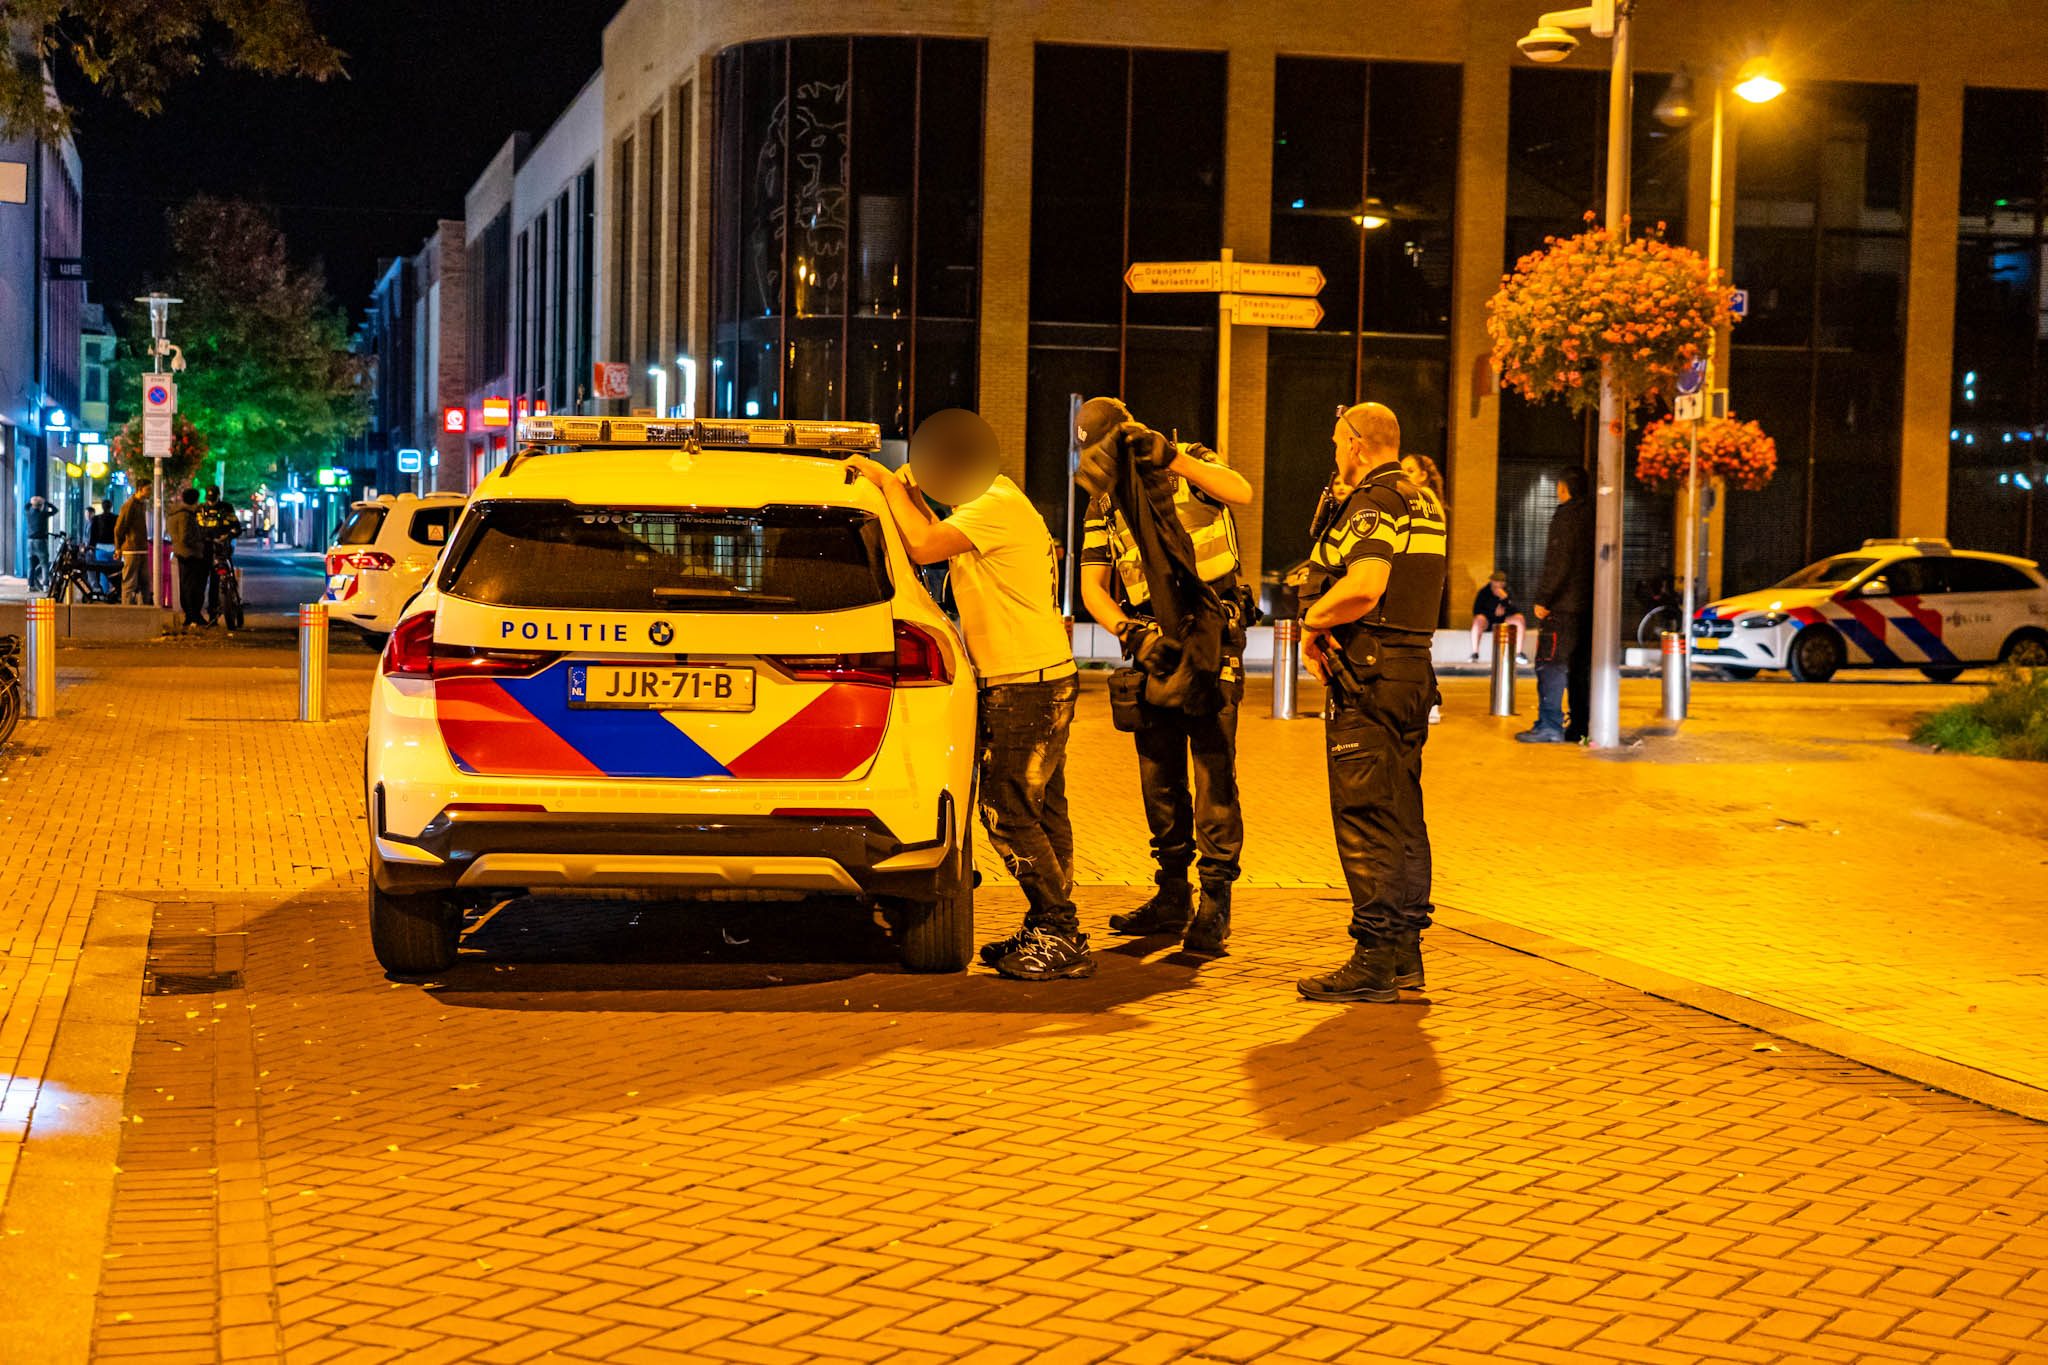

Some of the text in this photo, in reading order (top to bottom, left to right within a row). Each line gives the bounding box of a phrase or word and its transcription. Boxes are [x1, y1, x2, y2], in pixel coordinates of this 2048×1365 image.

[59, 263, 82, 276] WE
[501, 620, 628, 642] POLITIE
[571, 686, 585, 697] NL
[605, 670, 733, 699] JJR-71-B
